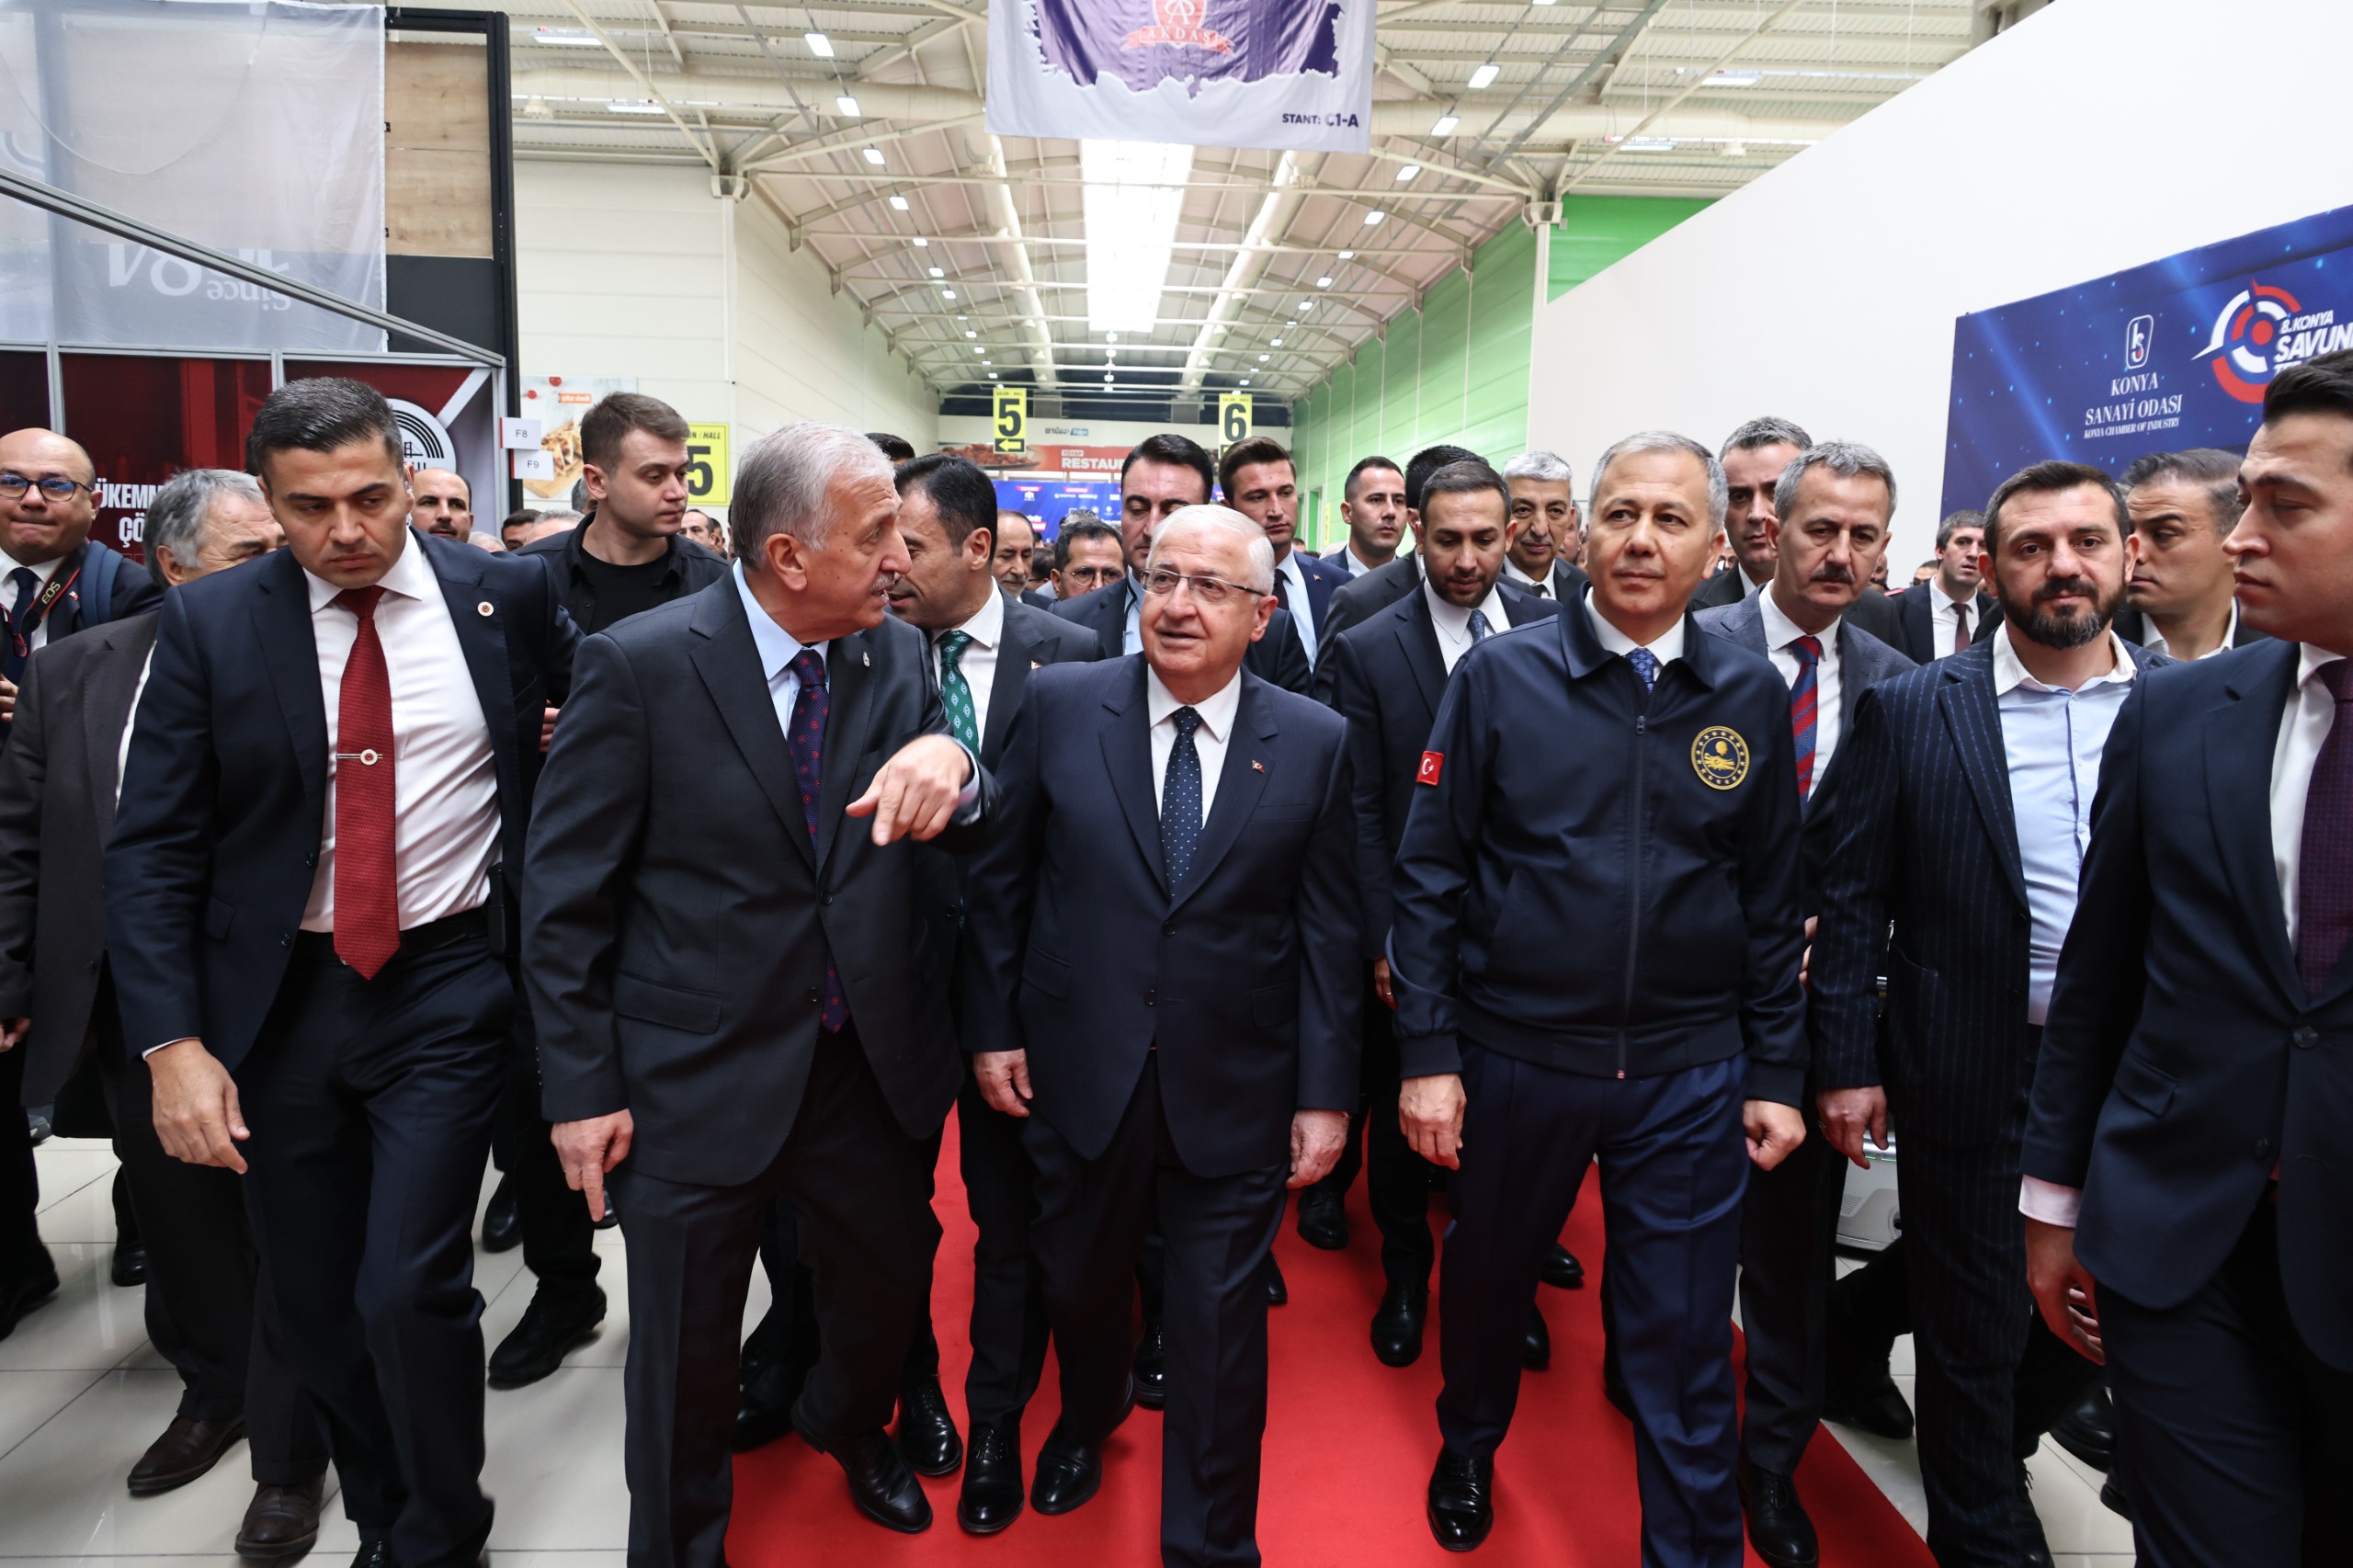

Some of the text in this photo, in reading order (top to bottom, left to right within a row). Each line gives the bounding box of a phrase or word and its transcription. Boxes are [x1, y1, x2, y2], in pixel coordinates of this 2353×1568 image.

[1282, 113, 1358, 128] STANT: C1-A
[2274, 322, 2353, 363] SAVUN
[2110, 371, 2158, 396] KONYA
[998, 398, 1021, 437] 5
[2085, 393, 2183, 426] SANAYİ ODASI
[516, 428, 529, 437] F8
[1224, 403, 1246, 441] 6
[2084, 416, 2181, 438] KONYA CHAMBER OF INDUSTRY
[702, 431, 721, 439] HALL
[527, 460, 540, 469] F9
[687, 446, 713, 496] 5
[41, 581, 62, 604] EOS
